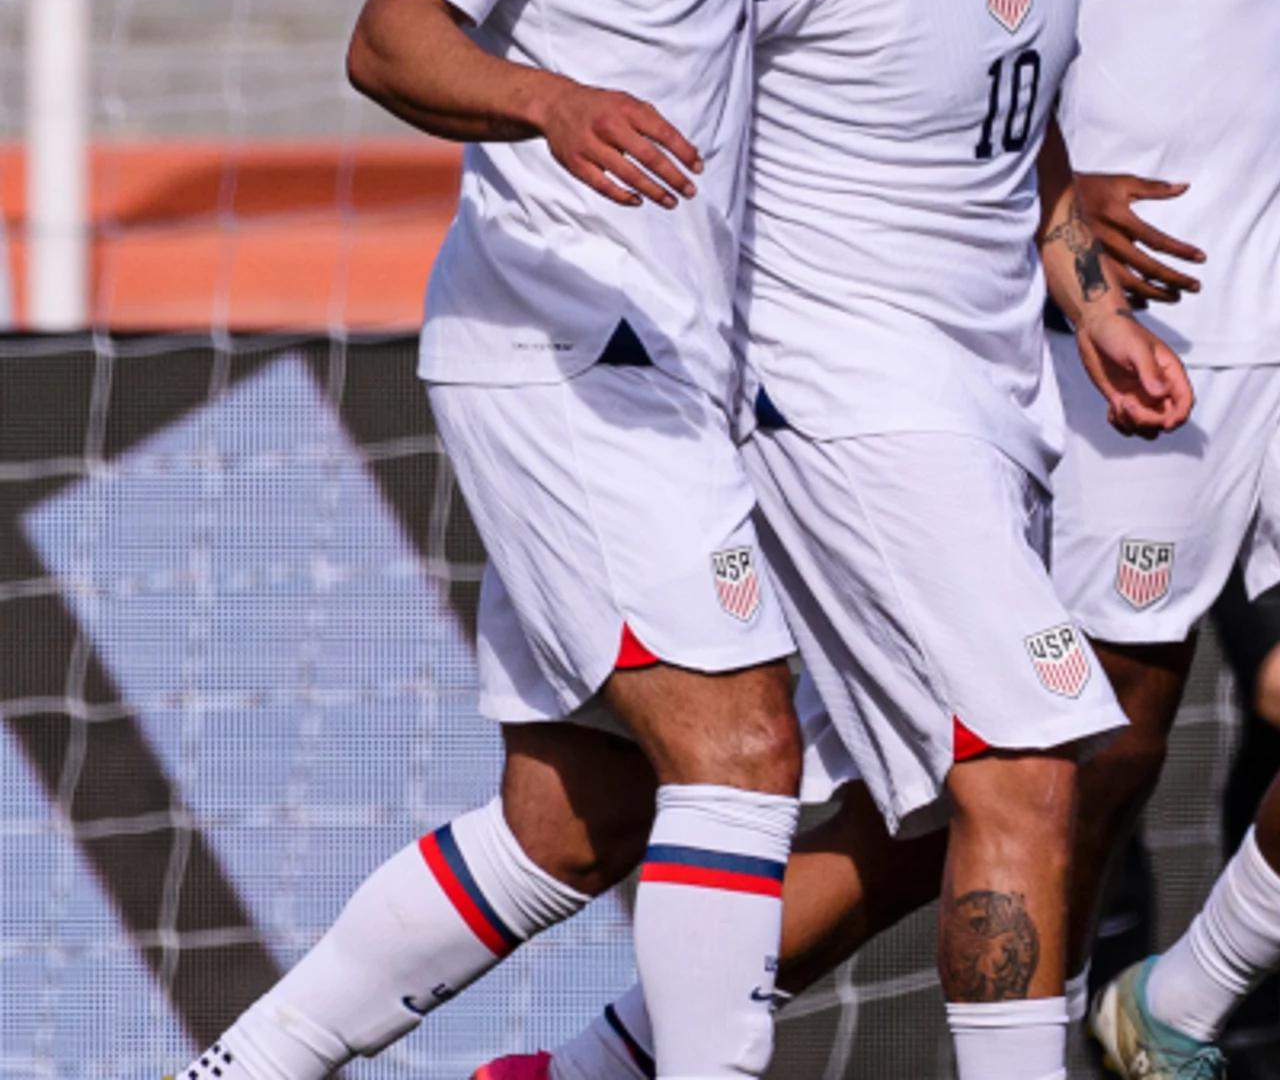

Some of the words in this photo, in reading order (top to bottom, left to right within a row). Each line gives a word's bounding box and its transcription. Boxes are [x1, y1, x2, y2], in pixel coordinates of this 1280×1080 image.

[974, 49, 1041, 159] 10
[712, 551, 750, 581] USA
[1125, 544, 1169, 572] USA
[1029, 628, 1073, 660] USA
